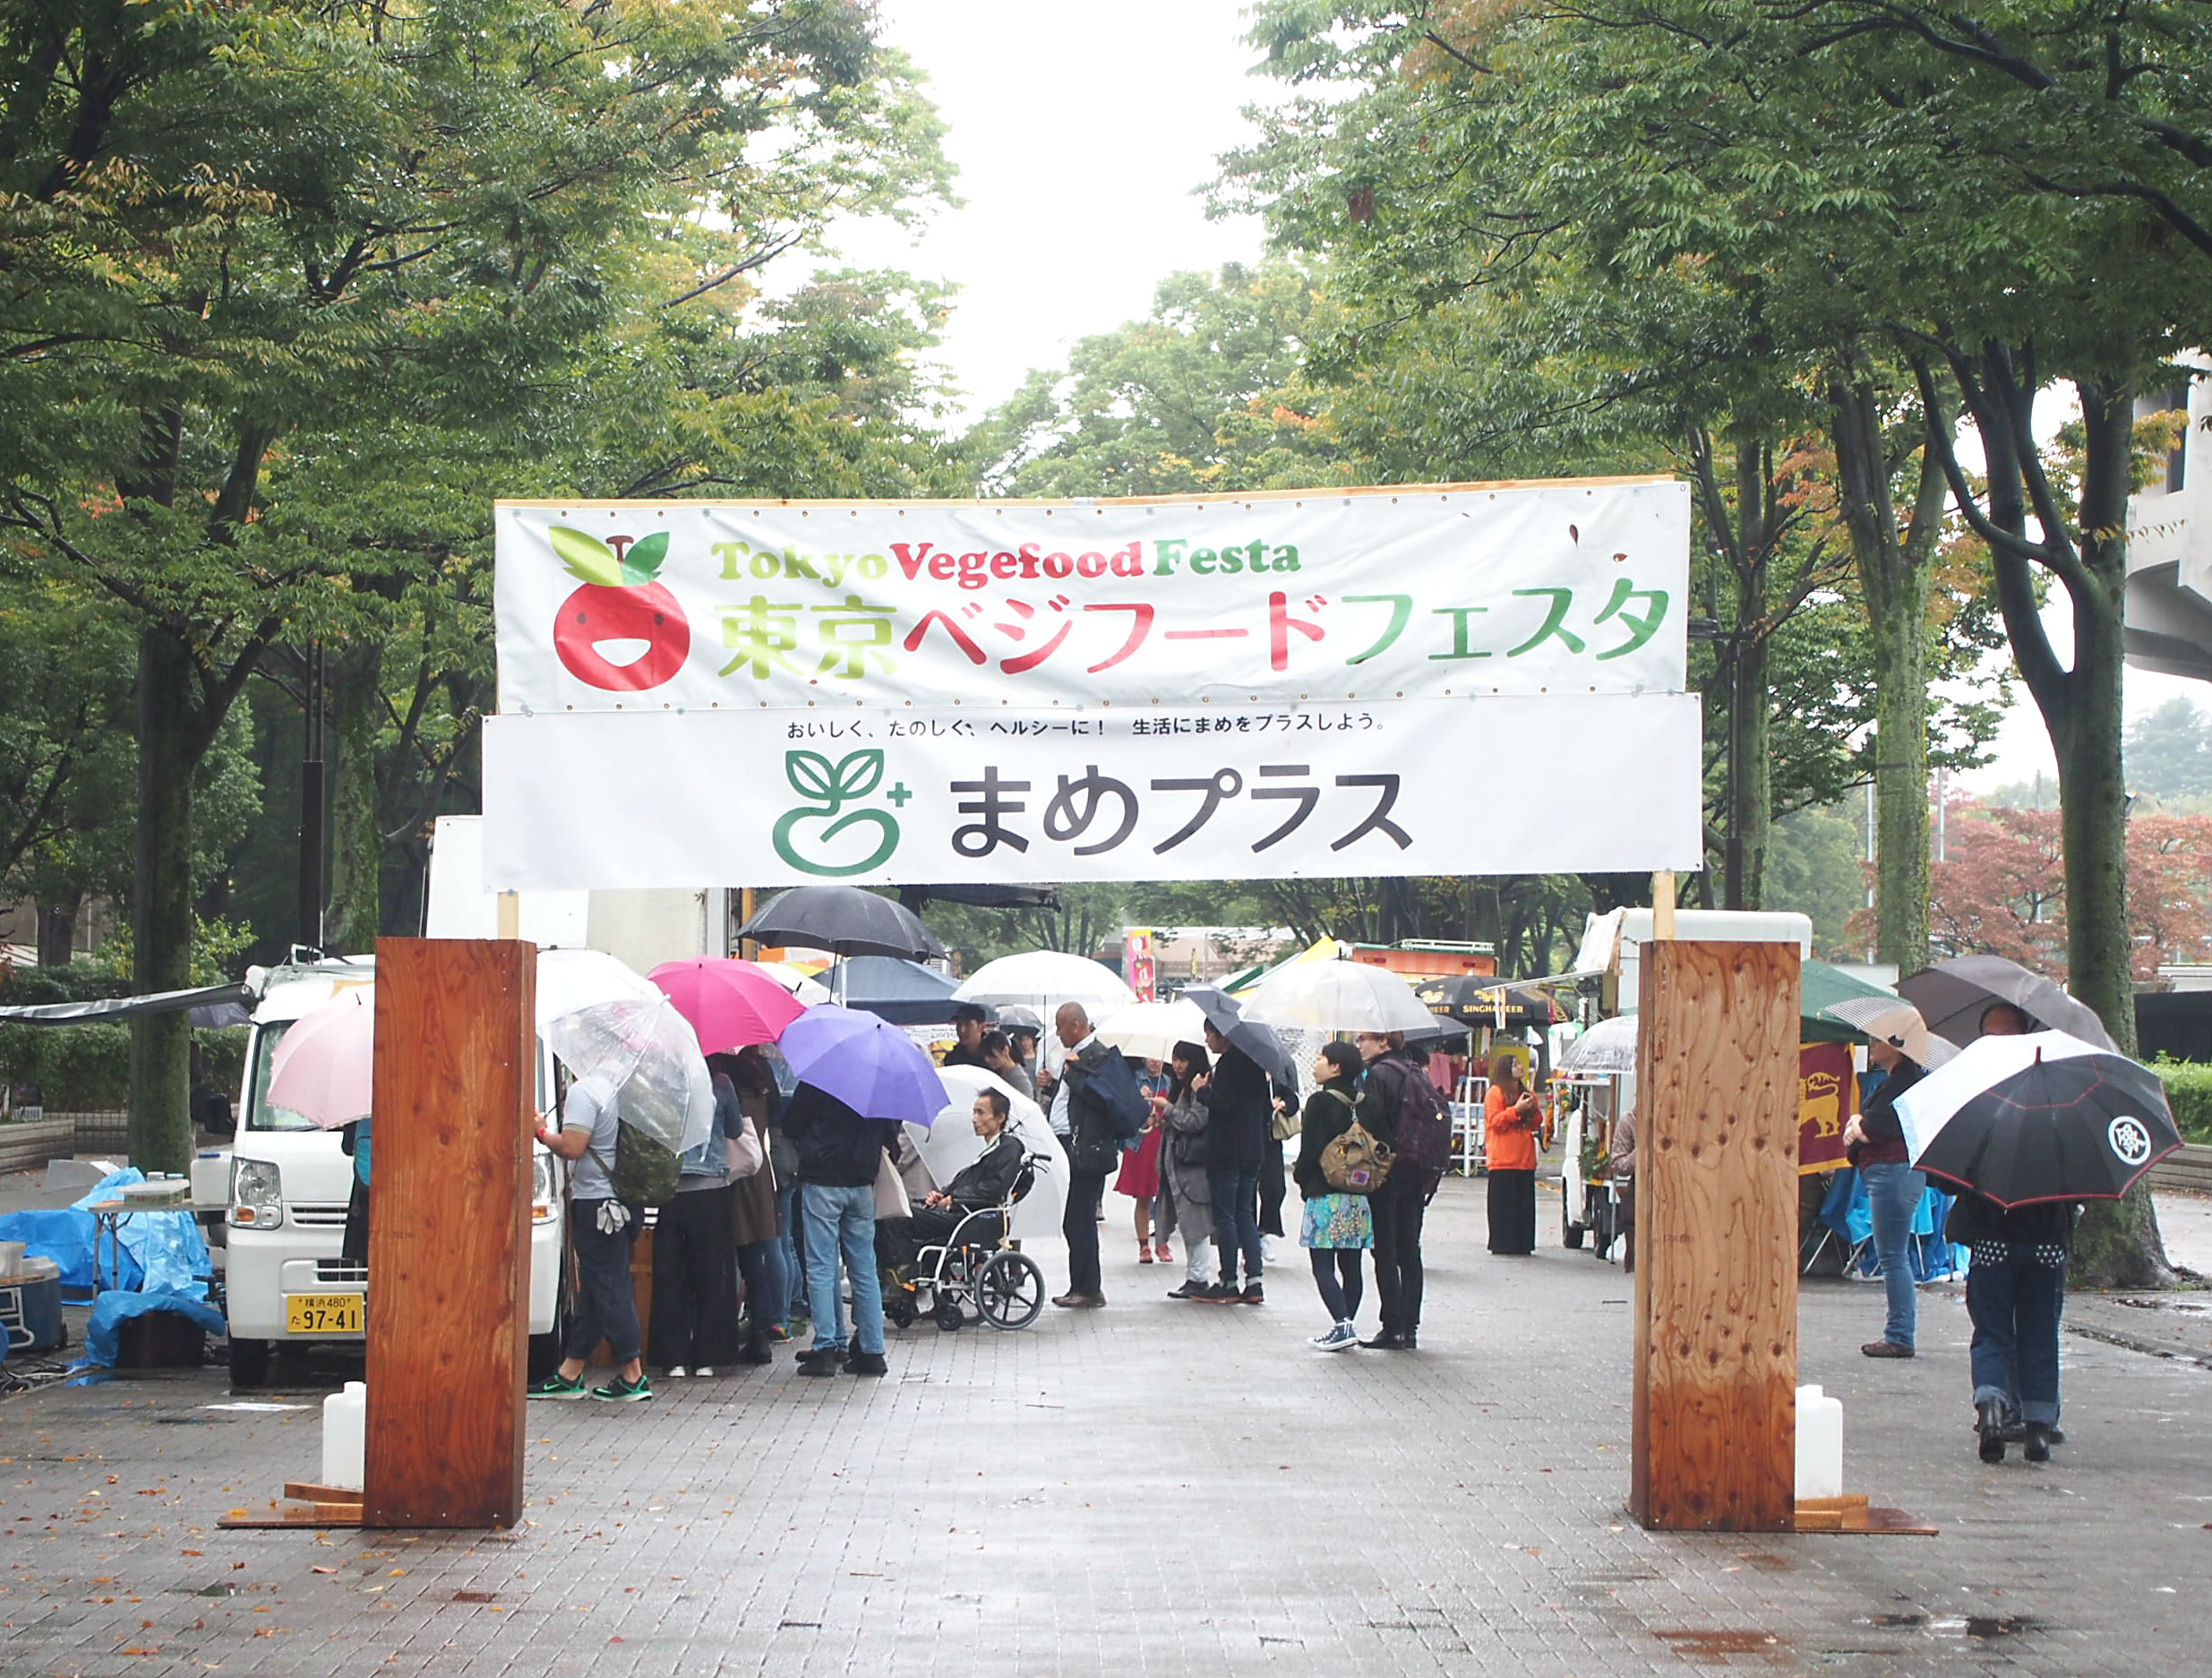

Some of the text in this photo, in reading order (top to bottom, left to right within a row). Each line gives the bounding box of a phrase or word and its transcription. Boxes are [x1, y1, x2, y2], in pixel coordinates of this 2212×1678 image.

[711, 538, 1302, 590] Tokyo Vegefood Festa
[715, 577, 1670, 681] 東京ベジフードフェスタ
[950, 764, 1413, 859] まめプラス
[304, 1310, 356, 1329] 97-41
[327, 1297, 346, 1307] 480
